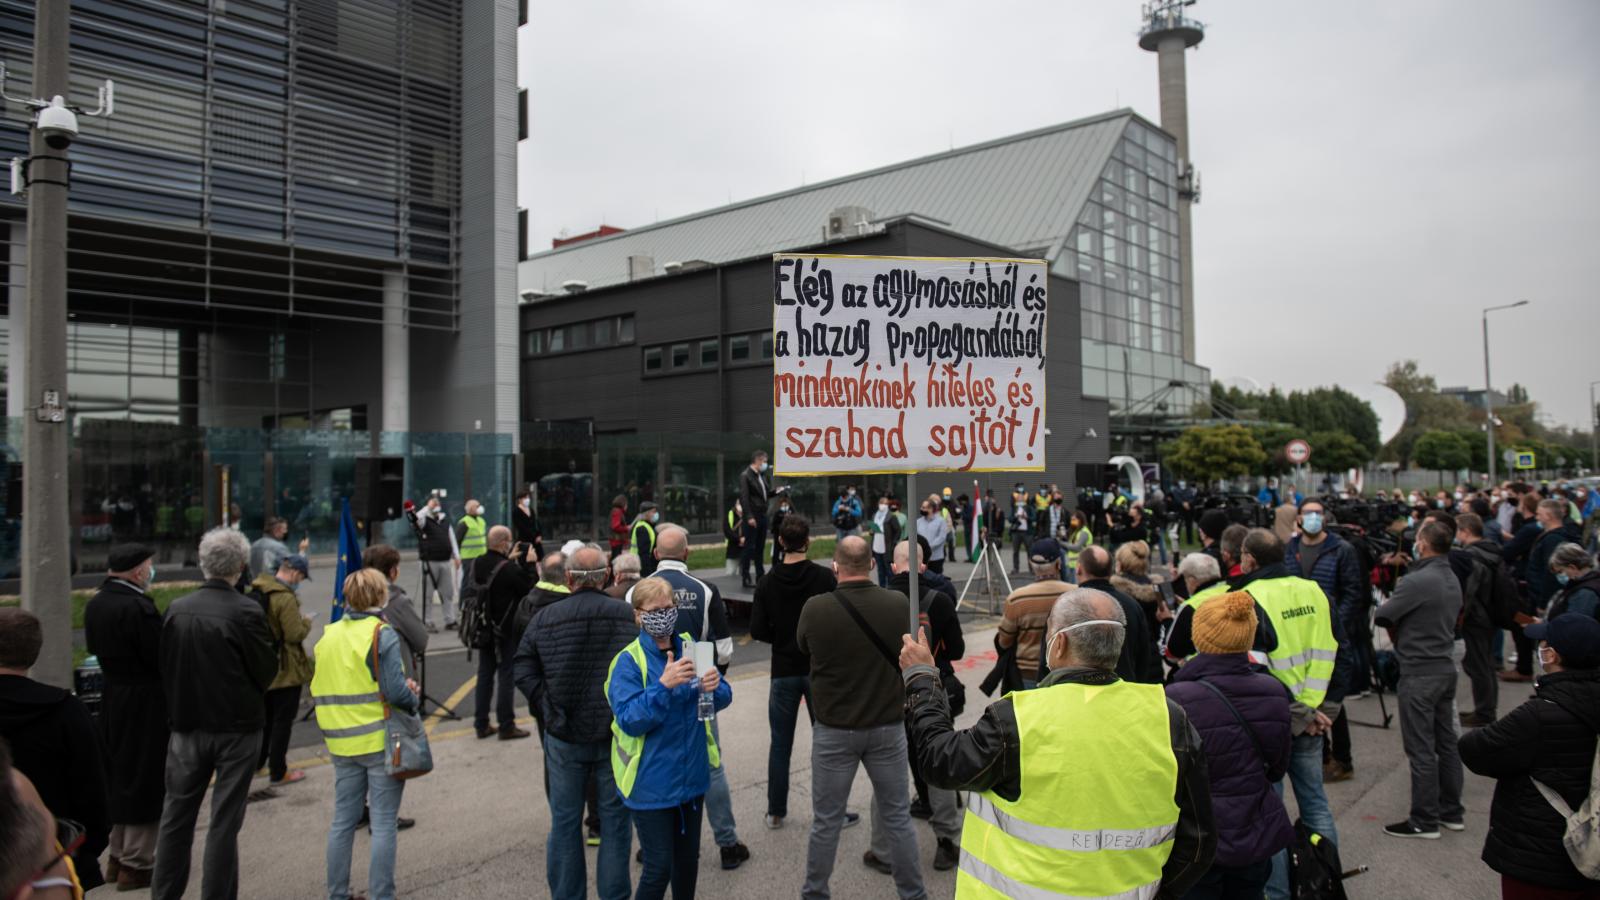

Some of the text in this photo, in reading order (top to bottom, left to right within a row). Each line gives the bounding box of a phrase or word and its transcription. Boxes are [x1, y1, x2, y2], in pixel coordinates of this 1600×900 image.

[775, 258, 1046, 318] Elég az agymosásból és
[775, 331, 790, 357] a
[796, 306, 870, 367] hazug
[774, 359, 1034, 410] mindenkinek hiteles és
[785, 409, 909, 459] szabad
